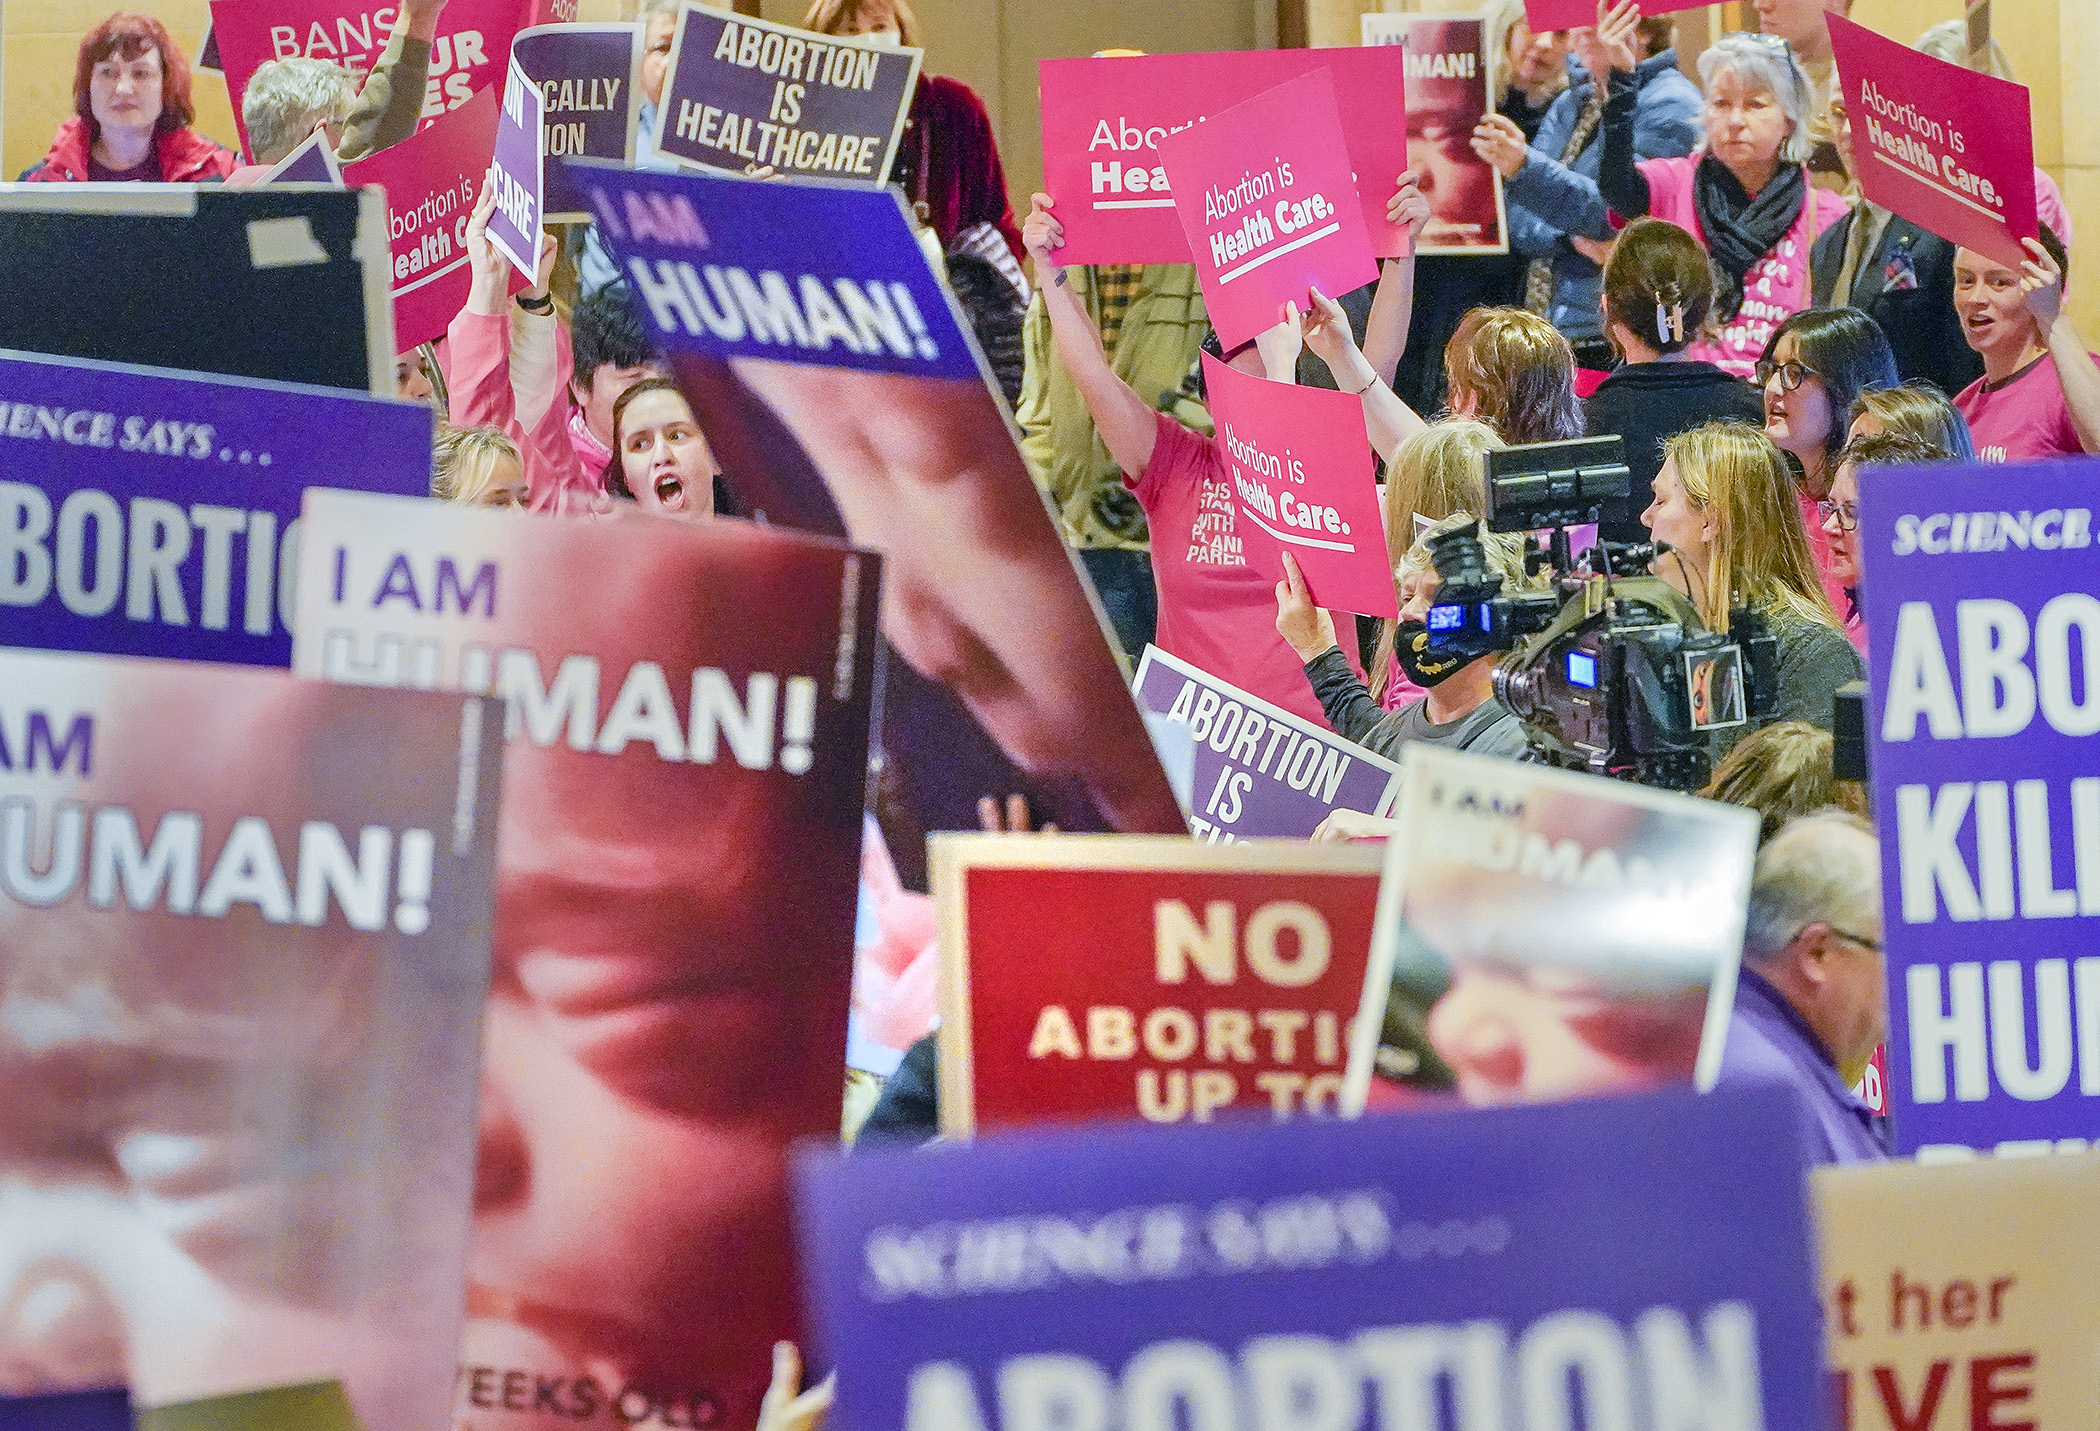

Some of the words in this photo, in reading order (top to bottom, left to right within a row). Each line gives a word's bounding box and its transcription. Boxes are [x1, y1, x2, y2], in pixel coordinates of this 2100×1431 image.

[270, 8, 397, 60] BANS
[714, 21, 880, 91] ABORTION
[535, 77, 621, 113] CALLY
[769, 80, 806, 124] IS
[1861, 78, 1944, 144] Abortion
[1947, 120, 1965, 153] is
[676, 99, 881, 174] HEALTHCARE
[1865, 115, 1939, 177] Health
[1942, 155, 2004, 207] Care.
[388, 190, 458, 242] bortion
[459, 174, 474, 203] is
[1205, 170, 1275, 225] Abortion
[1275, 156, 1294, 188] is
[1209, 209, 1274, 268] Health
[1274, 193, 1335, 235] Care.
[628, 254, 942, 362] HUMAN!
[1225, 422, 1283, 480] Abortion
[1286, 449, 1306, 485] is
[1232, 463, 1279, 522] Health
[1279, 491, 1352, 536] Care.
[1892, 507, 2093, 556] SCIENCE
[333, 546, 346, 604] I
[372, 551, 498, 618] AM
[0, 711, 95, 778] M
[1165, 679, 1352, 805] ABORTION
[1205, 764, 1253, 824] IS
[1153, 898, 1332, 988] NO
[1027, 1005, 1358, 1066] ABORTI
[1136, 1068, 1240, 1123] UP
[1888, 1265, 2019, 1336] her
[454, 1362, 598, 1420] EEKS
